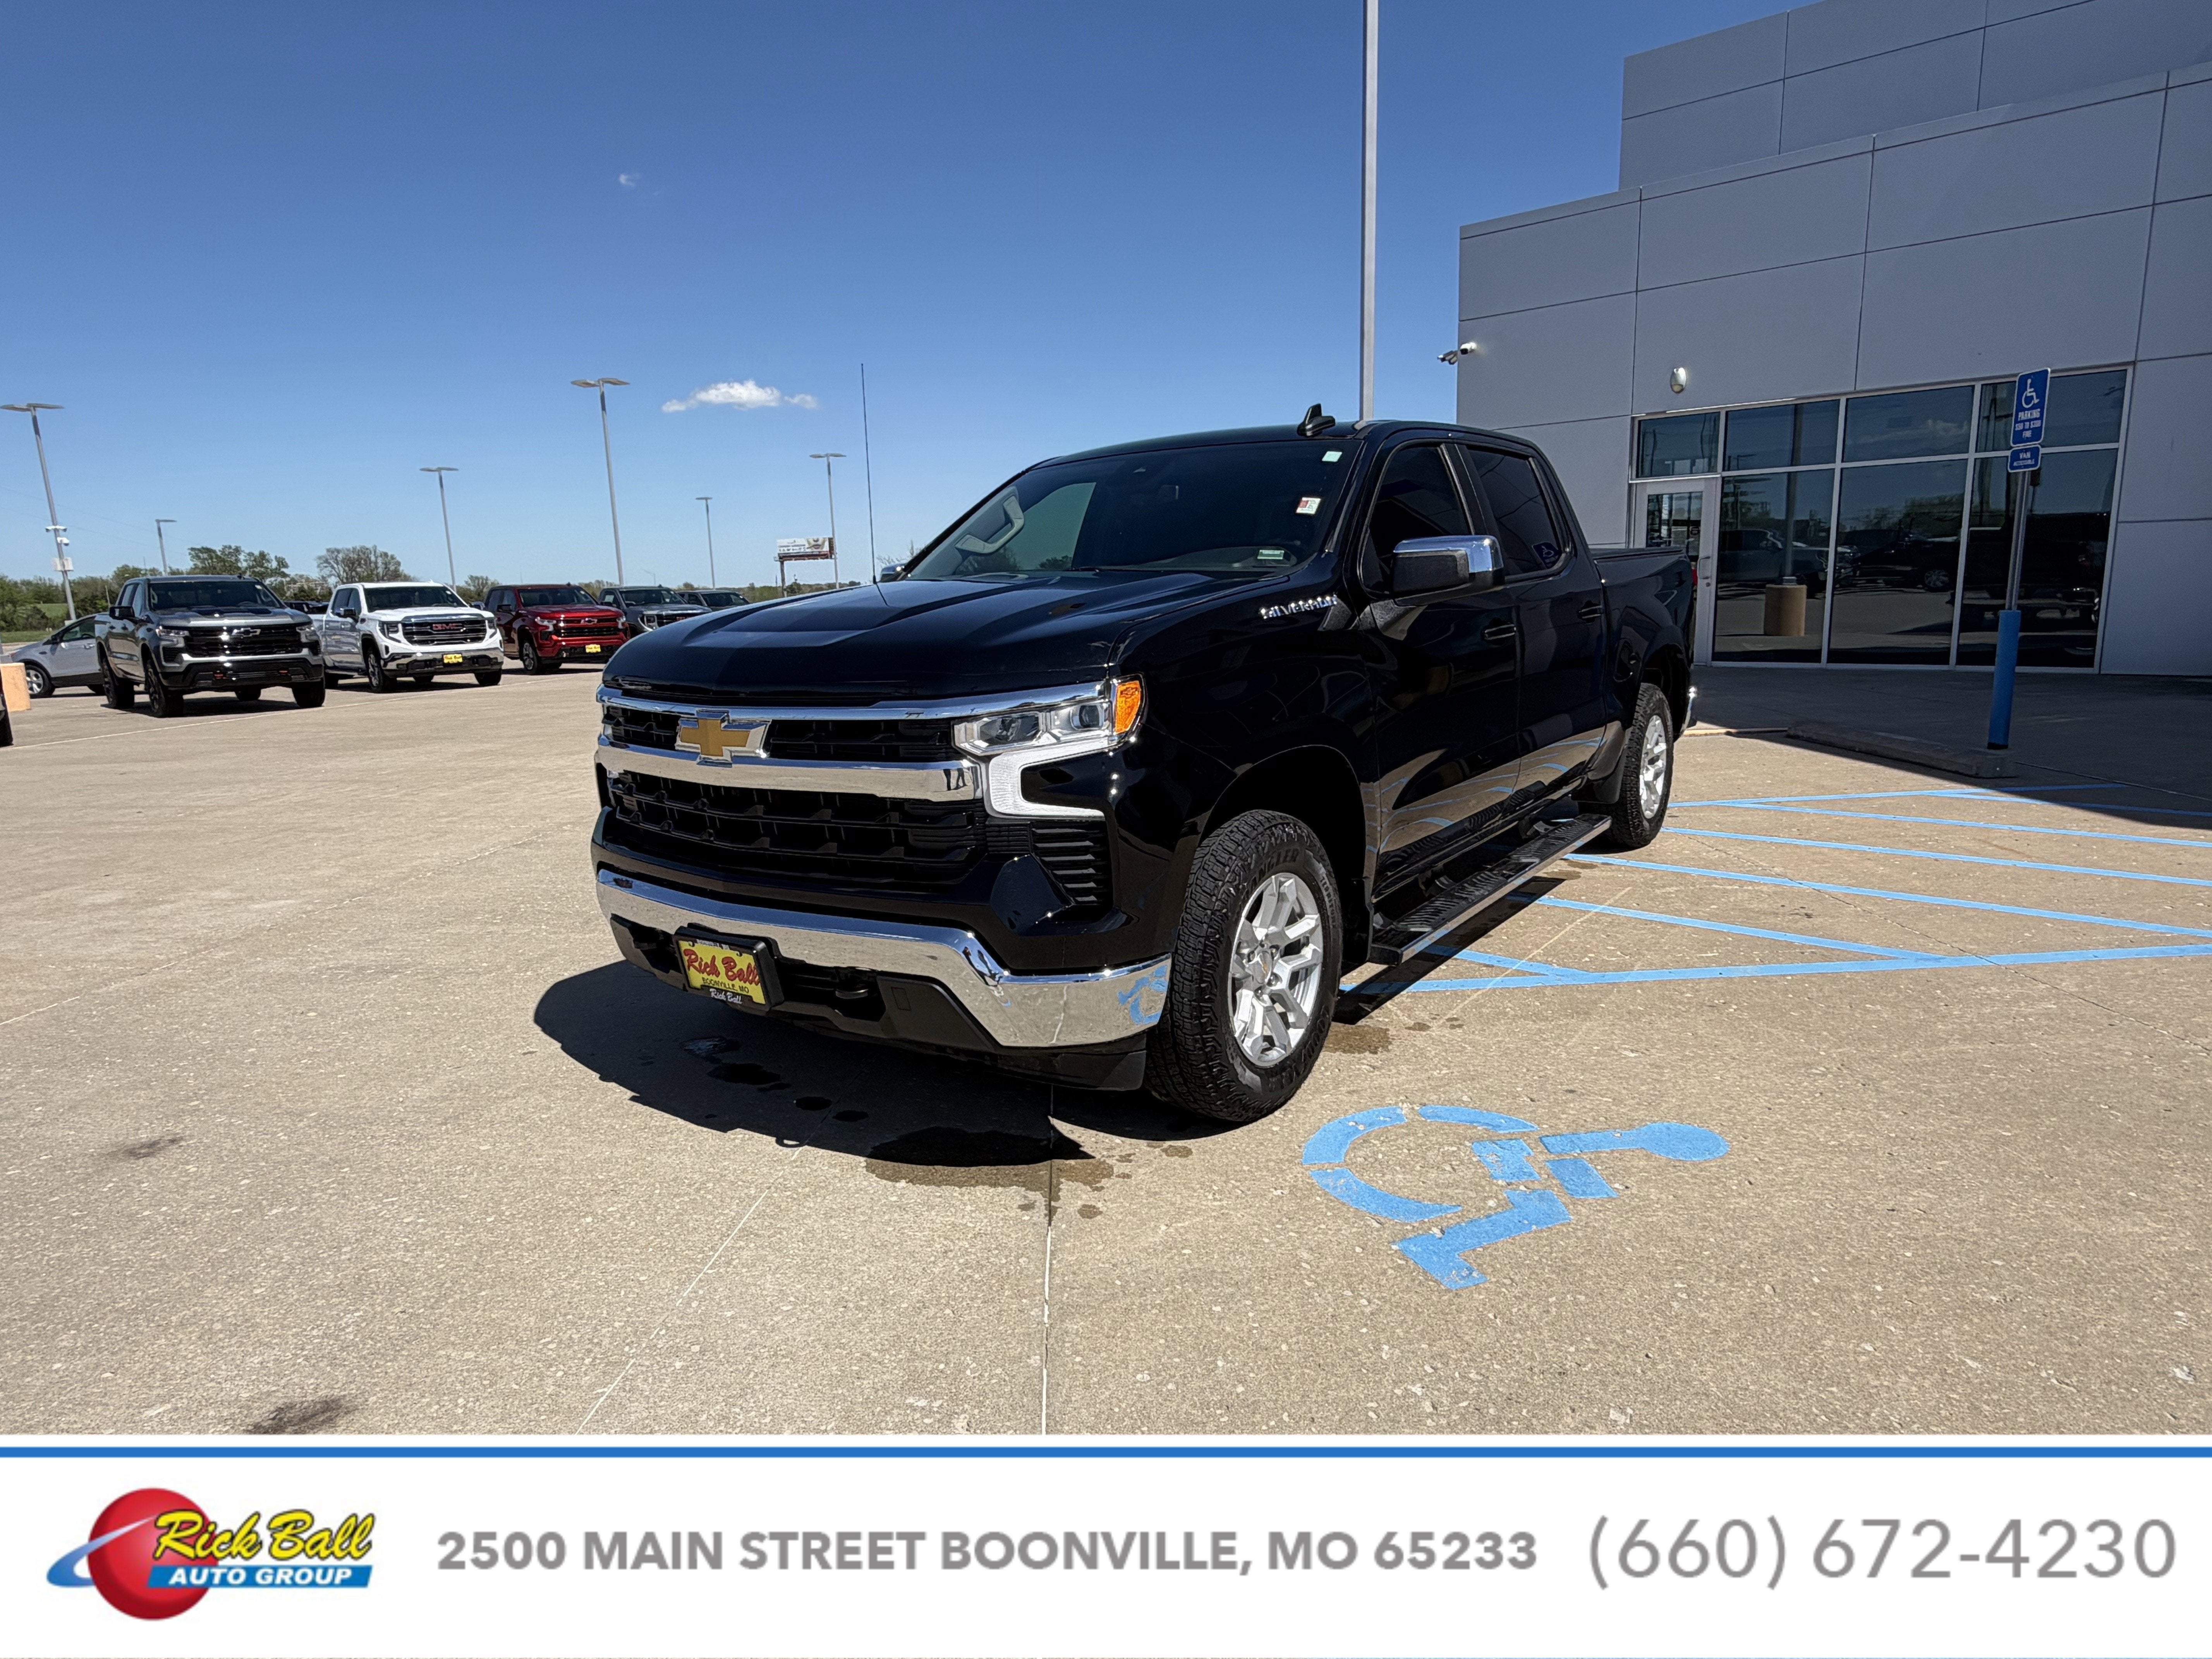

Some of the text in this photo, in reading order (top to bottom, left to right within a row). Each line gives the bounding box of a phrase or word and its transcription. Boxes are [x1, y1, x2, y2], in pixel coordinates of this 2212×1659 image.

[683, 948, 760, 986] Rick Ball
[702, 977, 749, 993] BOONVILLE MO
[709, 988, 742, 1004] Rick Ball
